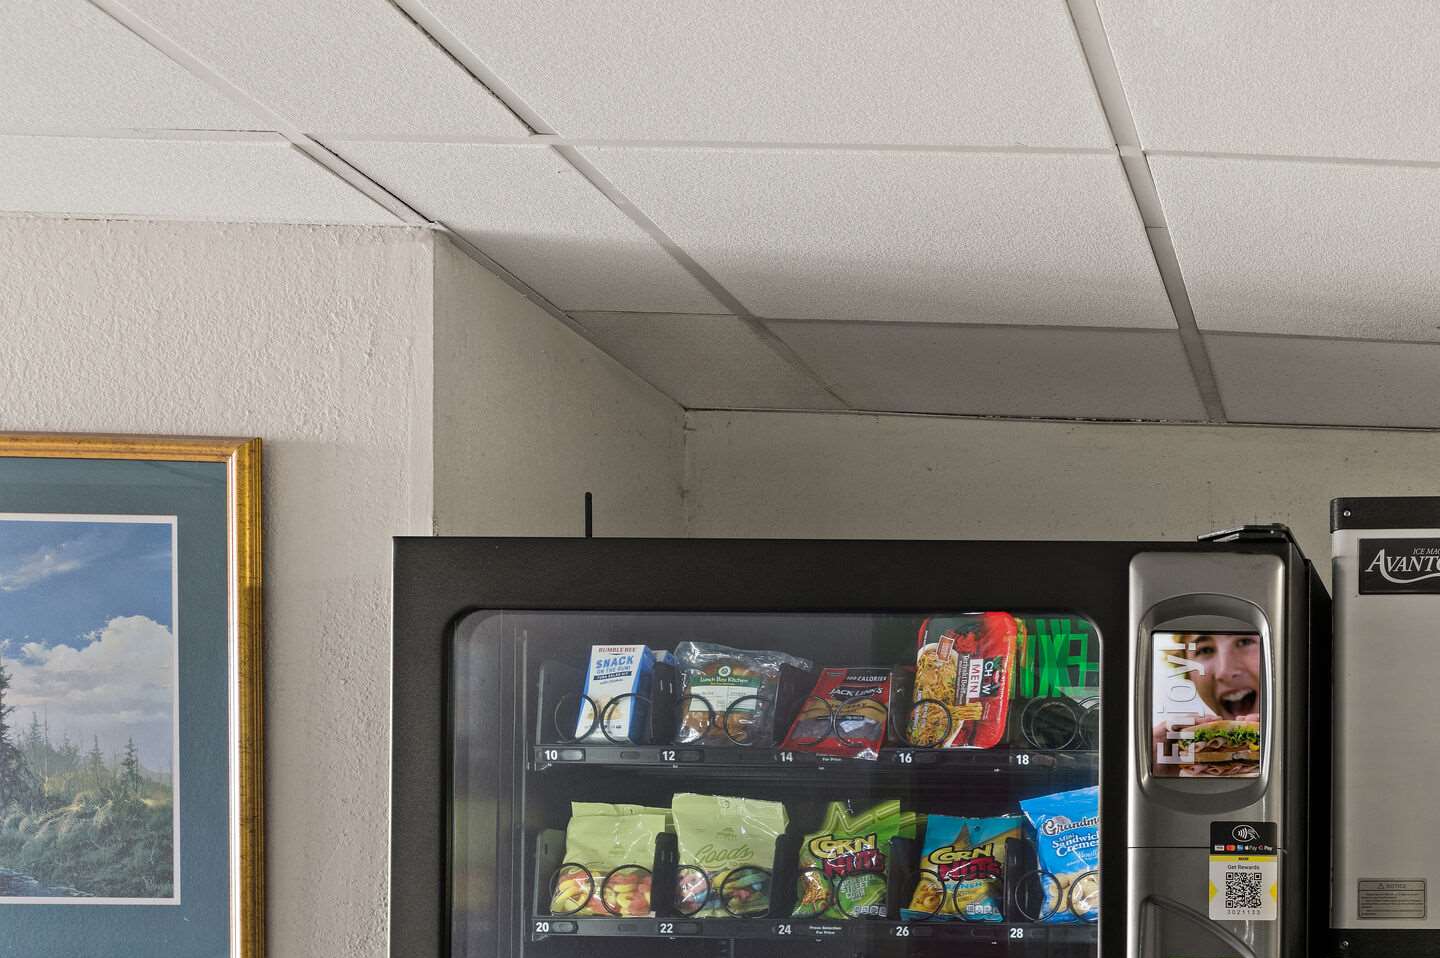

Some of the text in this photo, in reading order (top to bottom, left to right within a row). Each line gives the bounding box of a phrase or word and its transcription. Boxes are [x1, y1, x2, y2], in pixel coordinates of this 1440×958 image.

[1413, 547, 1425, 555] ICE
[595, 655, 634, 669] SNACK
[970, 664, 980, 694] MEIN
[1156, 639, 1206, 765] Enjoy!
[544, 750, 558, 761] 10
[662, 751, 676, 761] 12
[780, 752, 793, 762] 14
[899, 753, 912, 763] 16
[1016, 754, 1030, 765] 18
[1042, 815, 1100, 836] Grandm
[808, 833, 878, 860] CORN
[928, 843, 994, 865] CORN
[535, 921, 549, 933] 20
[660, 923, 673, 934] 22
[778, 924, 792, 934] 24
[895, 926, 909, 937] 26
[1009, 928, 1023, 938] 28
